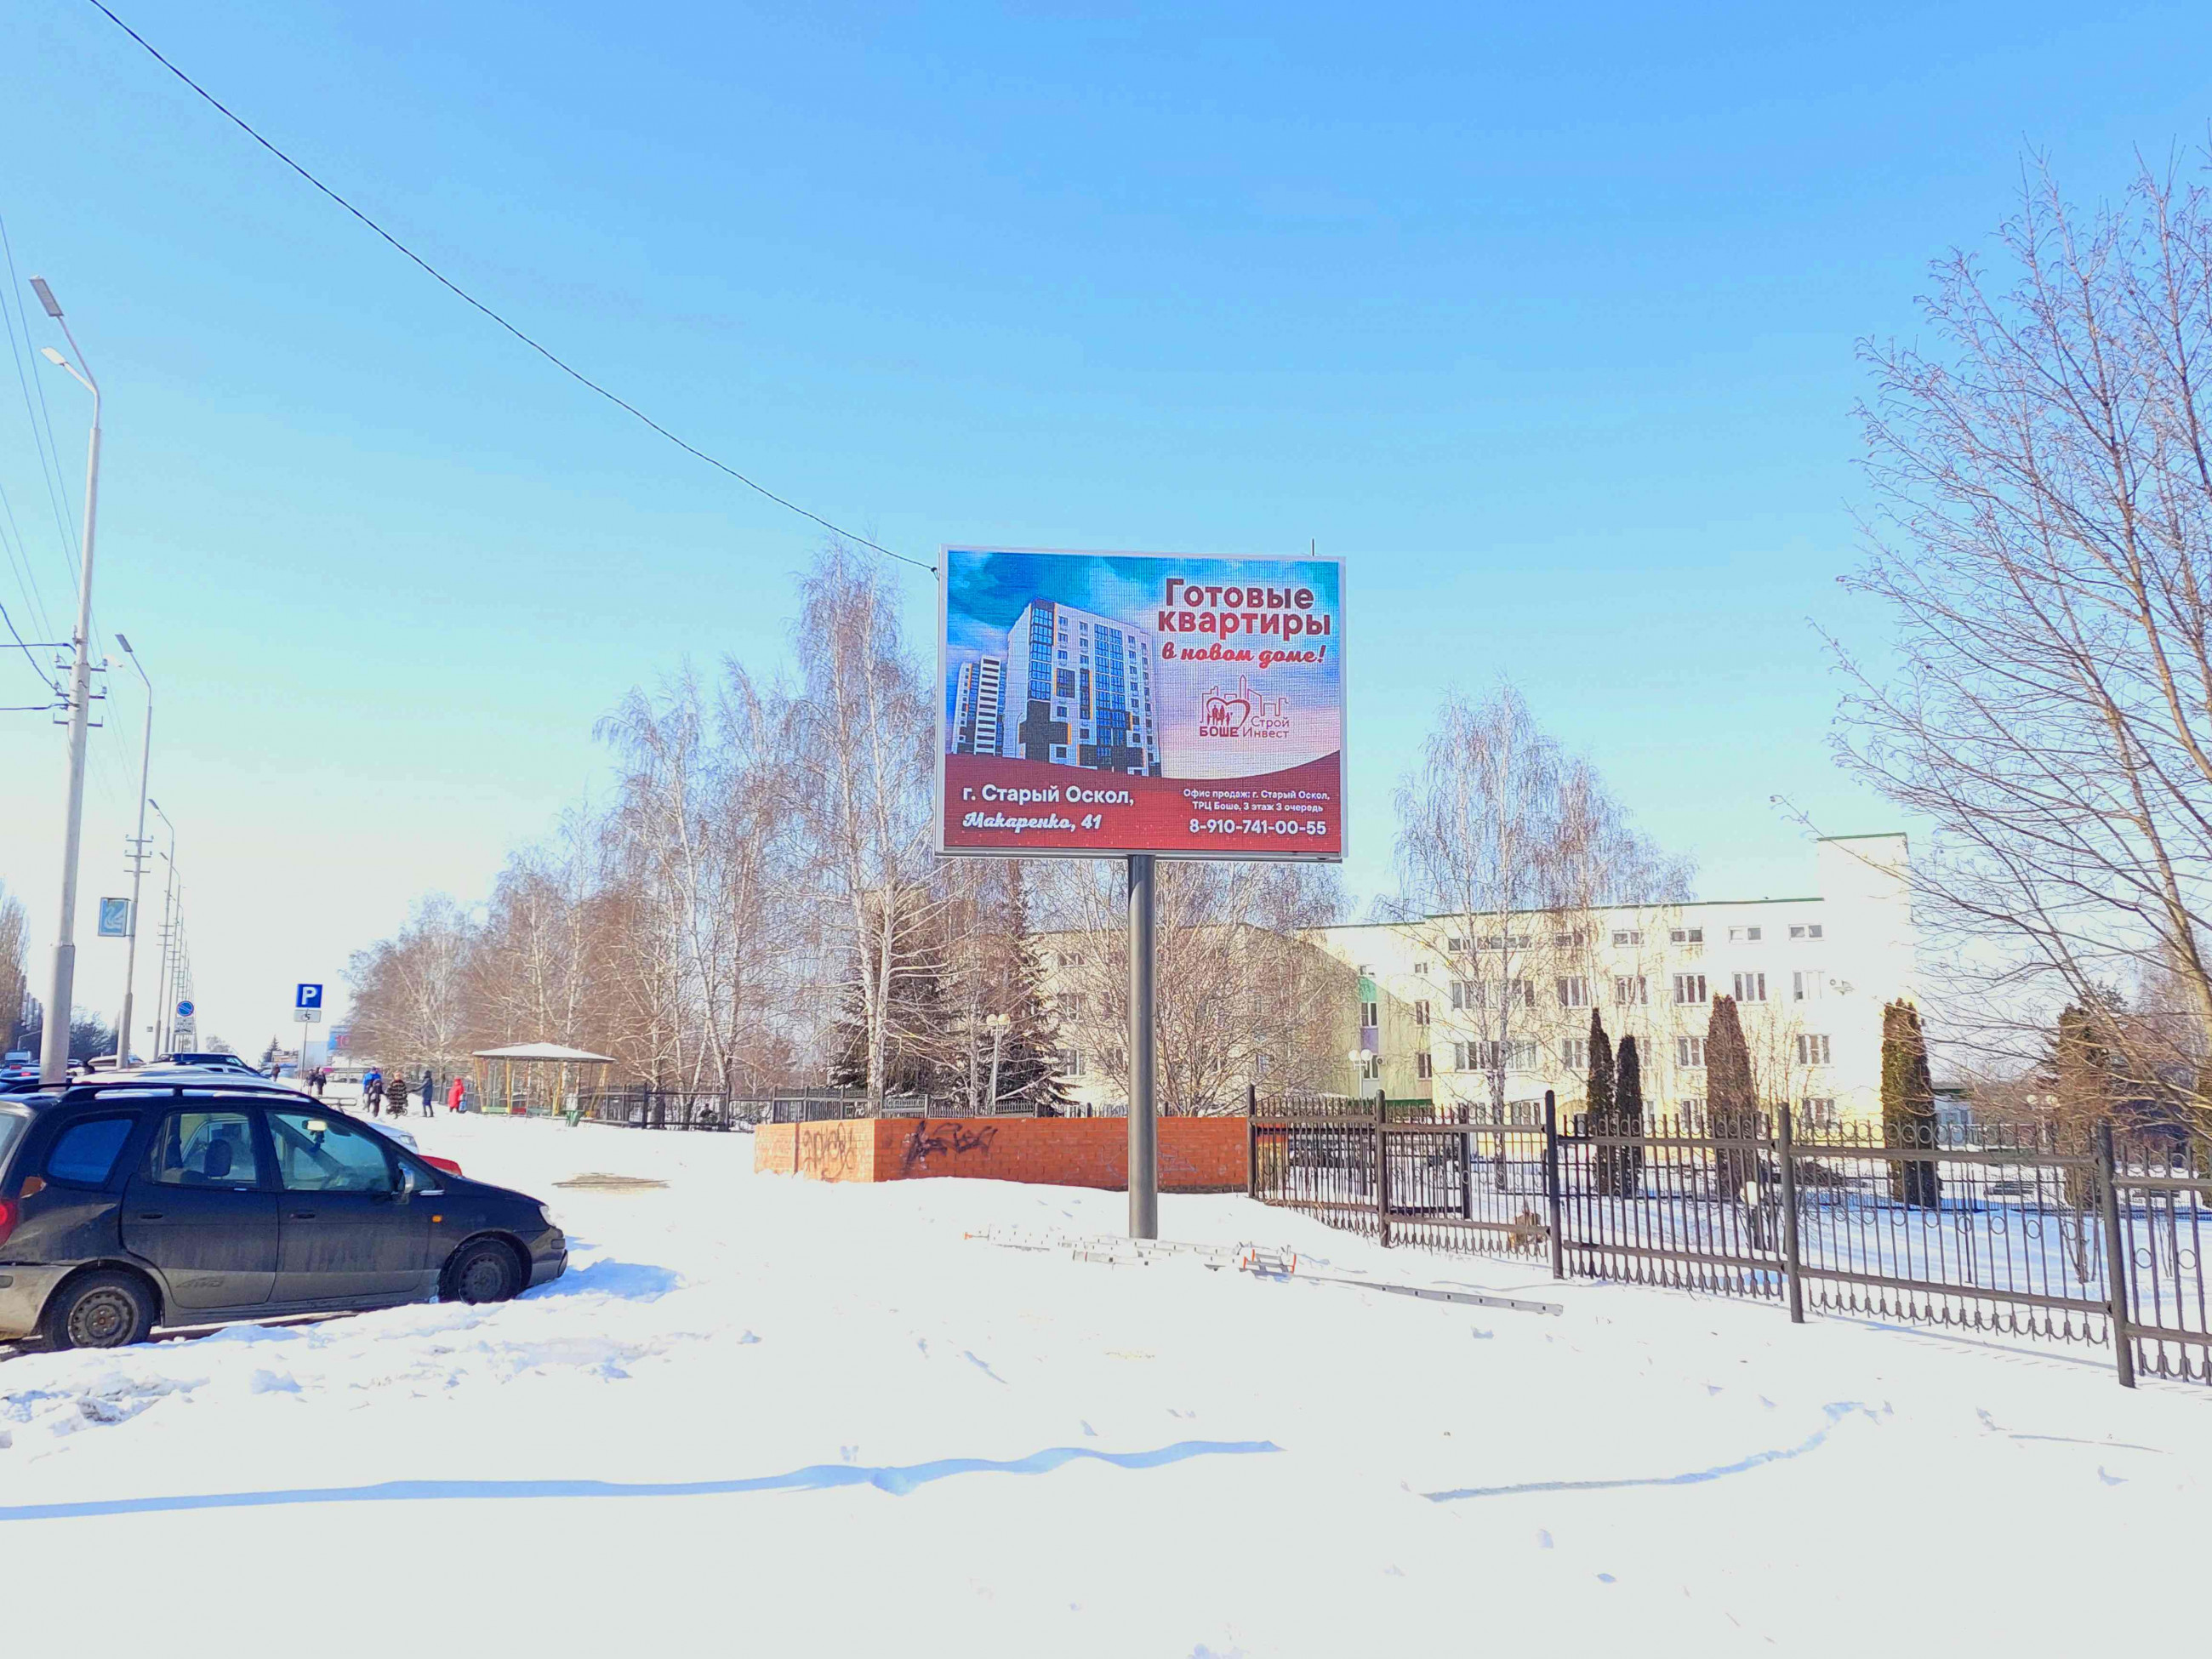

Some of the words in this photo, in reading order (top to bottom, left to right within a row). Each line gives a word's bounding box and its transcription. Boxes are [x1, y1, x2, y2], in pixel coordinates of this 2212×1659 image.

[1166, 578, 1314, 609] Готовые
[1158, 611, 1331, 641] квартиры
[1162, 641, 1177, 659] в
[1181, 642, 1255, 662] новом
[1258, 645, 1327, 669] доме!
[1251, 715, 1290, 729] Строй
[1199, 726, 1240, 738] БОШЕ
[1242, 727, 1290, 738] Инвест
[962, 787, 976, 801] г.
[981, 784, 1060, 806] Старый
[1065, 785, 1135, 807] Оскол,
[1183, 789, 1211, 800] Офис
[1212, 790, 1251, 801] продаж:
[1261, 789, 1297, 800] Старый
[1298, 790, 1331, 801] Оскол,
[1192, 801, 1211, 811] ТРЦ
[1214, 801, 1242, 812] Боше,
[1276, 802, 1282, 811] 3
[1284, 804, 1324, 813] очередь
[962, 811, 1076, 833] Макаренко,
[1080, 813, 1103, 830] 41
[1189, 818, 1327, 835] 8-910-741-00-55
